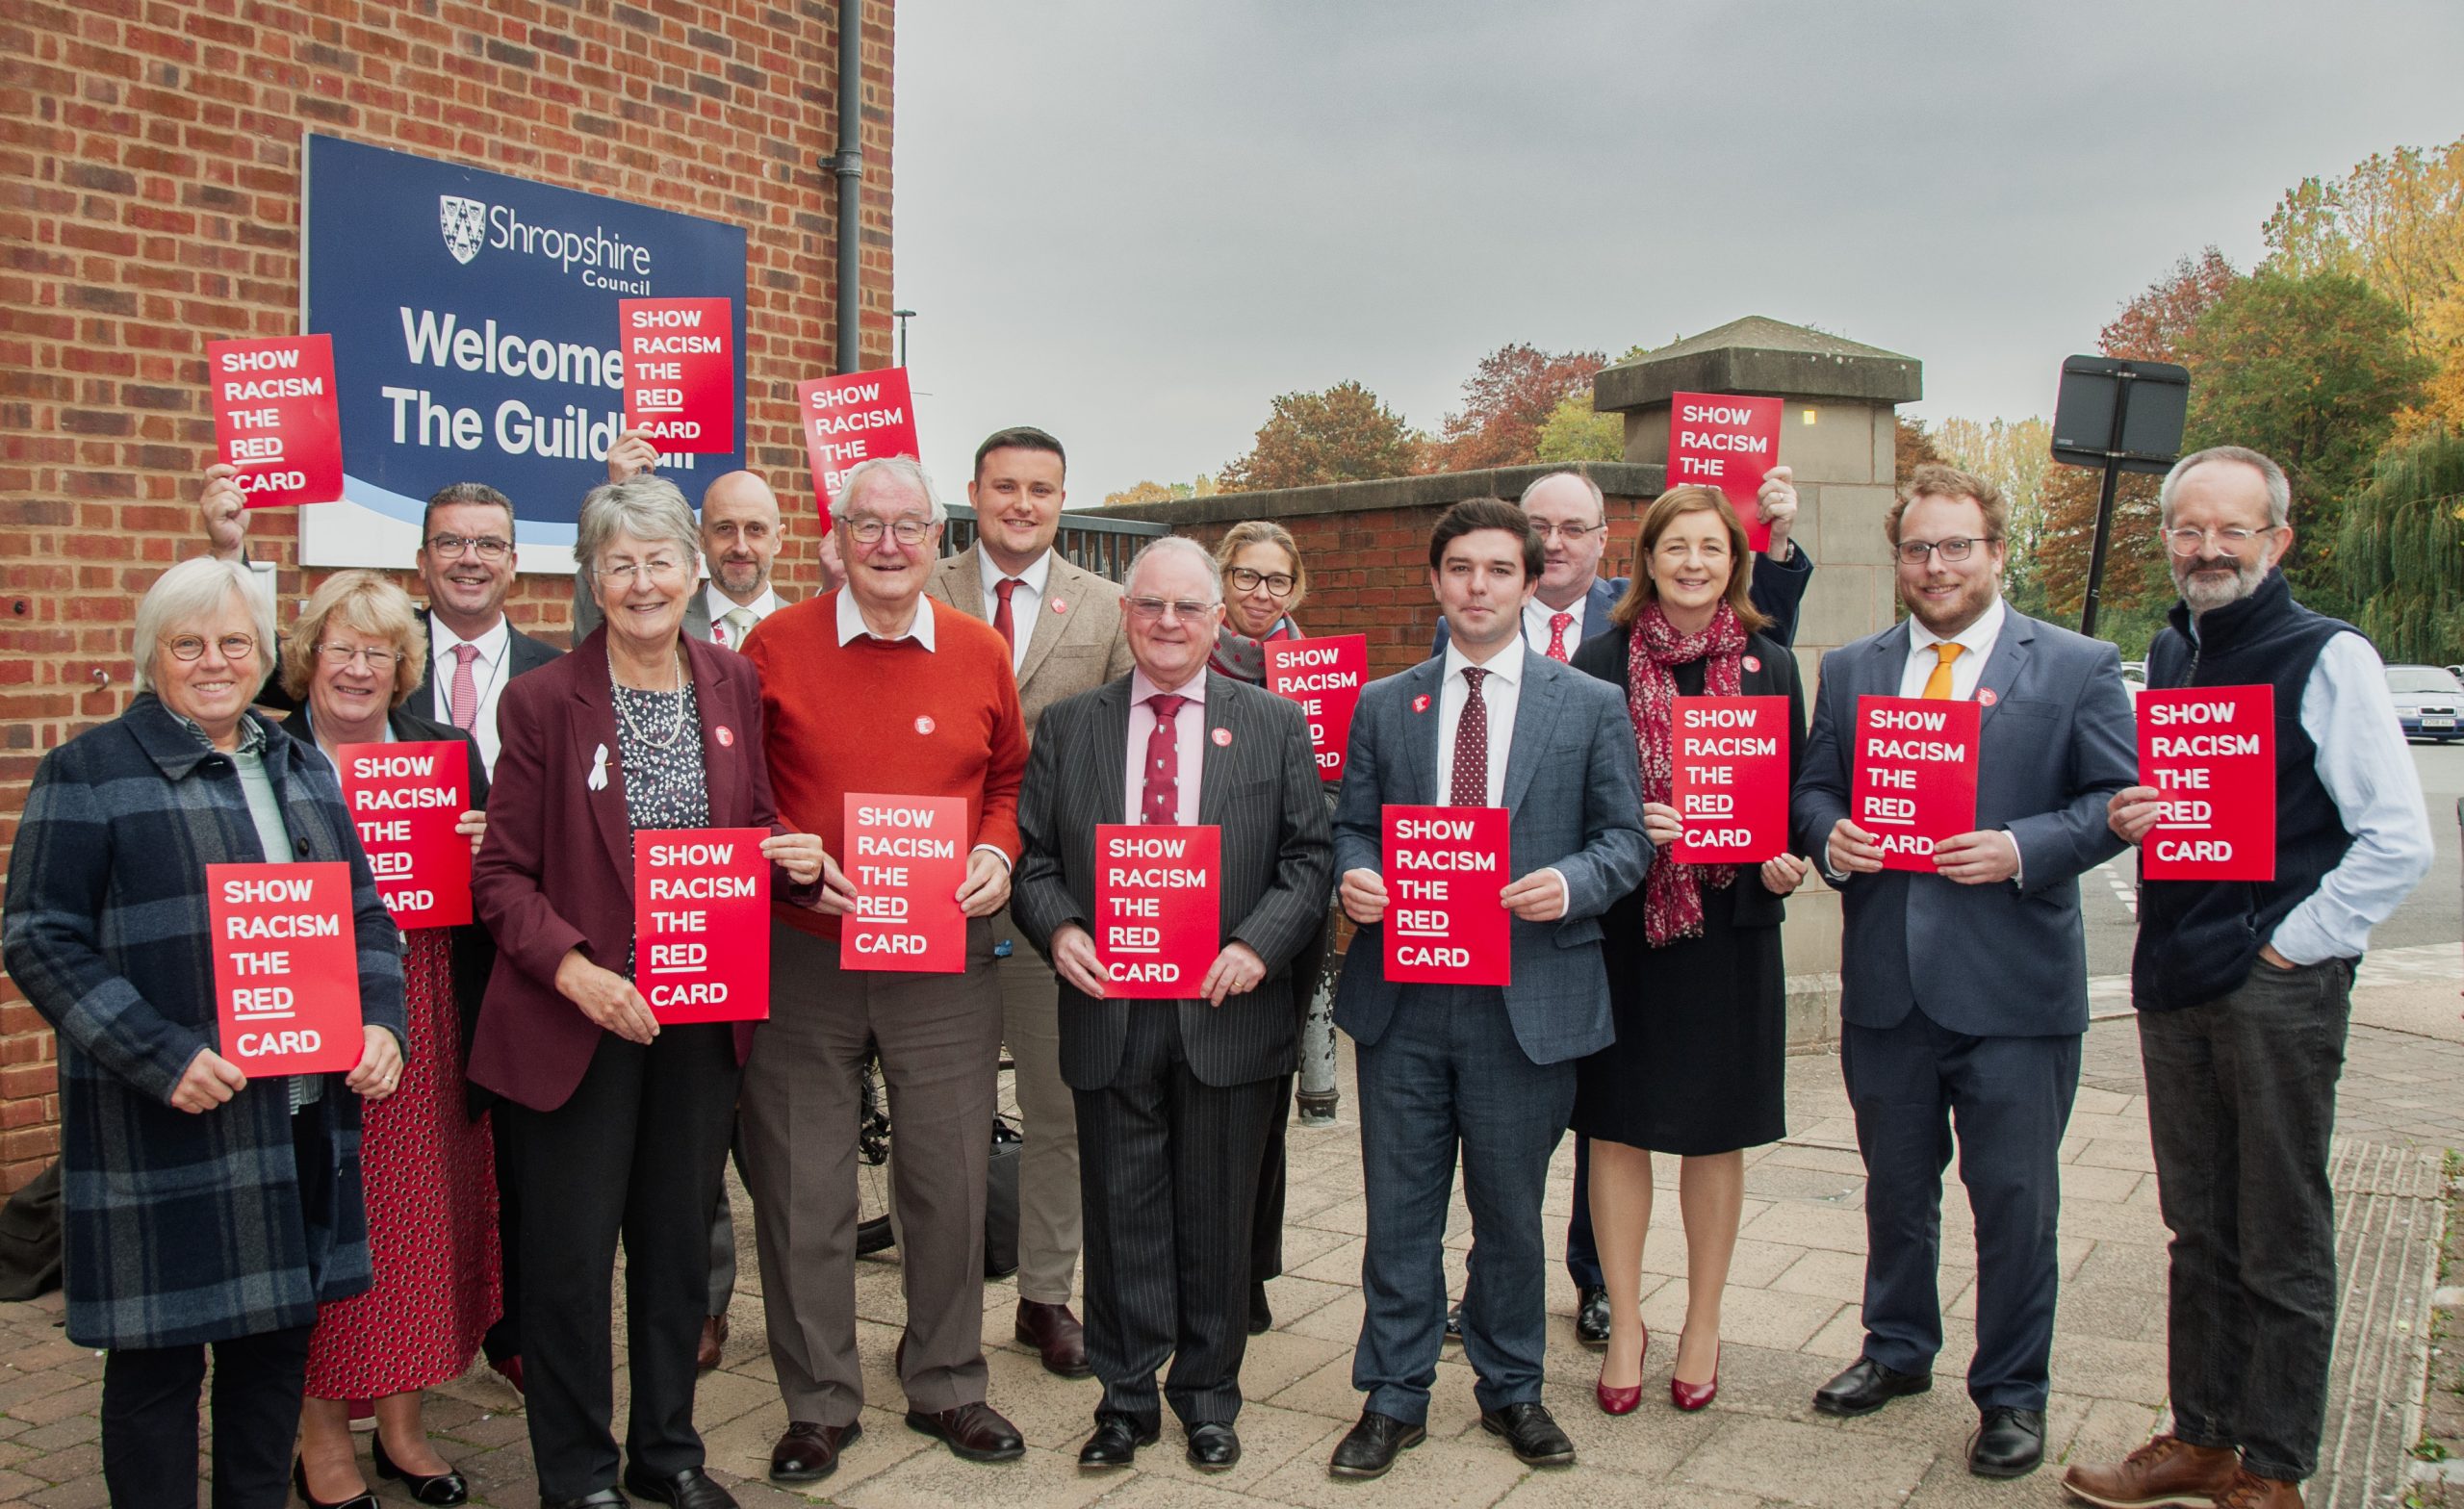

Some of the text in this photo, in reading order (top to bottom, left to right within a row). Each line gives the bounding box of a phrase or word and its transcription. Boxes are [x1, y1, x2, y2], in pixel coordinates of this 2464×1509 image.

[490, 206, 650, 274] Shropshire
[582, 269, 650, 295] Council
[632, 311, 701, 327] SHOW
[400, 307, 624, 390] Welcome
[633, 337, 720, 354] RACISM
[222, 349, 298, 371] SHOW
[635, 363, 681, 380] THE
[225, 377, 322, 400] RACISM
[636, 389, 682, 406] RED
[810, 383, 879, 409] SHOW
[228, 408, 280, 429] THE
[382, 386, 482, 449] The
[815, 407, 903, 436] RACISM
[1683, 406, 1752, 425] SHOW
[230, 437, 284, 458] RED
[820, 440, 867, 462] THE
[1681, 431, 1767, 453] RACISM
[1680, 457, 1724, 475] THE
[234, 472, 306, 493] CARD
[1276, 649, 1338, 668] SHOW
[1278, 672, 1357, 693] RACISM
[1684, 710, 1757, 728] SHOW
[1870, 709, 1946, 730] SHOW
[2150, 703, 2235, 725] SHOW
[1685, 738, 1775, 755] RACISM
[1868, 739, 1964, 762] RACISM
[2152, 734, 2259, 757] RACISM
[354, 756, 433, 778] SHOW
[1685, 767, 1732, 783] THE
[1867, 768, 1916, 788] THE
[2153, 769, 2210, 789] THE
[356, 787, 456, 810] RACISM
[1685, 795, 1733, 812] RED
[1865, 797, 1915, 817] RED
[859, 807, 934, 828] SHOW
[2156, 801, 2212, 822] RED
[358, 821, 411, 842] THE
[1397, 820, 1475, 840] SHOW
[1685, 830, 1751, 847] CARD
[650, 844, 733, 866] SHOW
[859, 836, 954, 858] RACISM
[1110, 839, 1186, 857] SHOW
[2157, 841, 2232, 861] CARD
[366, 852, 413, 874] RED
[1397, 850, 1495, 871] RACISM
[859, 866, 908, 886] THE
[1110, 868, 1205, 887] RACISM
[224, 880, 313, 903] SHOW
[651, 877, 755, 900] RACISM
[1398, 881, 1448, 900] THE
[383, 889, 434, 912] ARD
[857, 896, 908, 916] RED
[1110, 898, 1159, 916] THE
[227, 914, 339, 939] RACISM
[651, 911, 706, 933] THE
[1398, 909, 1449, 930] RED
[856, 934, 926, 954] CARD
[1110, 927, 1160, 946] RED
[230, 952, 290, 975] THE
[652, 944, 706, 965] RED
[1398, 947, 1469, 967] CARD
[1109, 962, 1180, 982] CARD
[233, 987, 294, 1011] RED
[651, 984, 728, 1006] CARD
[238, 1031, 321, 1057] CARD
